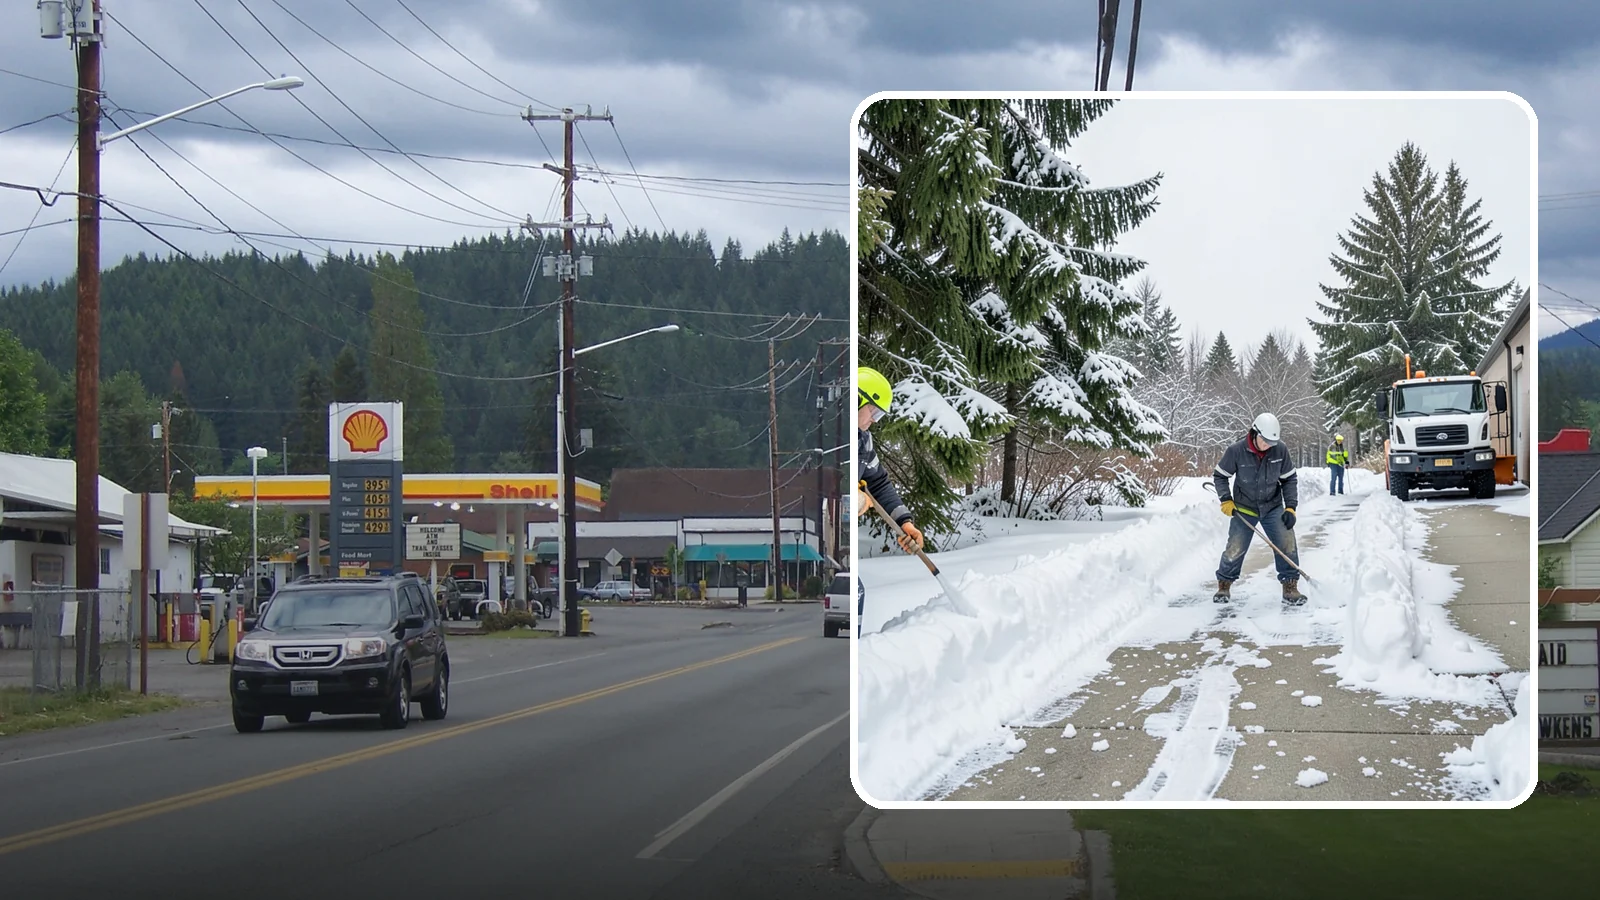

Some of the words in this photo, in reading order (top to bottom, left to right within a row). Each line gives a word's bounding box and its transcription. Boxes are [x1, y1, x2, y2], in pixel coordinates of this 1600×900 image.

[366, 480, 383, 490] 395
[490, 484, 547, 499] Shell
[366, 494, 383, 504] 405
[366, 508, 383, 518] 415
[366, 522, 384, 533] 429
[1538, 642, 1567, 665] AID
